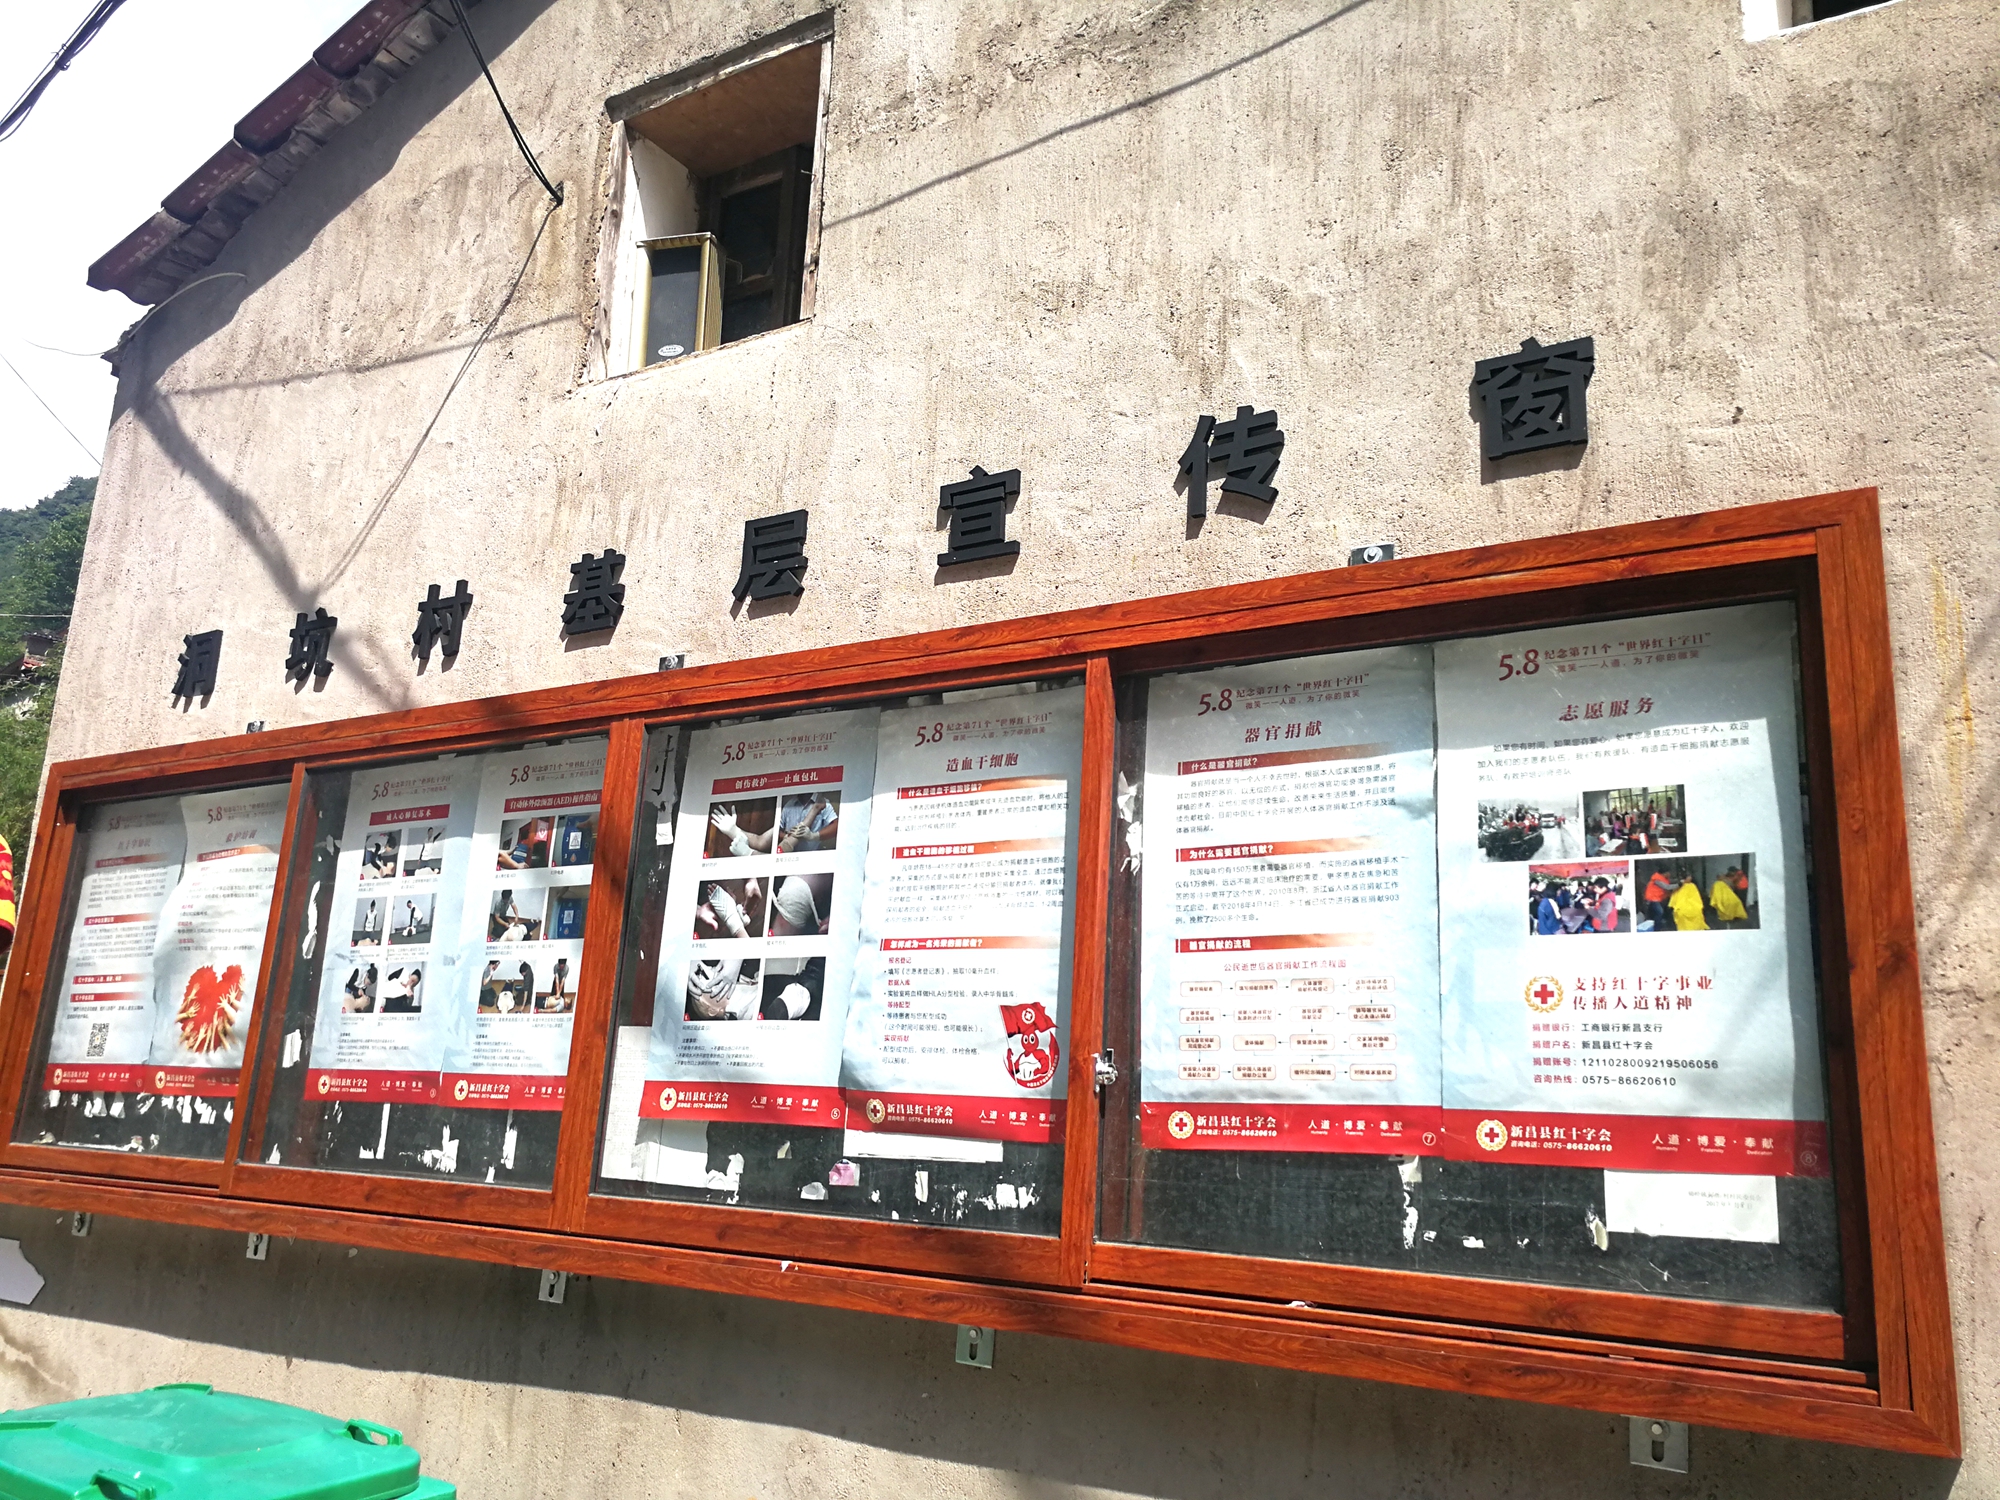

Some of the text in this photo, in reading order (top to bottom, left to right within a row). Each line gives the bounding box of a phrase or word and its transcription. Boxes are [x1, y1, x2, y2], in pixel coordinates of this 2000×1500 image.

[174, 336, 1596, 702] 洞坑村基层宣传窗
[1499, 632, 1712, 681] 5.8 纪念第71个“世界红十字日”
[1198, 672, 1370, 716] 5.8 纪念第71个“世界红十字日”
[1559, 697, 1655, 722] 志愿服务
[915, 723, 943, 747] 5.8
[1244, 720, 1322, 743] 器官捐献
[722, 742, 745, 764] 5.8
[946, 752, 1019, 772] 造血干细胞
[509, 765, 530, 786] 5.8
[735, 772, 818, 789] 创伤救护——止血包扎
[372, 782, 390, 801] 5.8
[208, 806, 222, 824] 5.8
[1572, 974, 1714, 992] 支持红十字事业
[1572, 995, 1693, 1011] 传播人道精神
[678, 1092, 729, 1102] 新昌县红十字会
[887, 1103, 953, 1117] 新昌县红十字会
[1196, 1115, 1403, 1132] 新昌县红十字会 人道·博爱·奉献
[1510, 1124, 1774, 1151] 新昌县红十字会 人道·博爱·奉献
